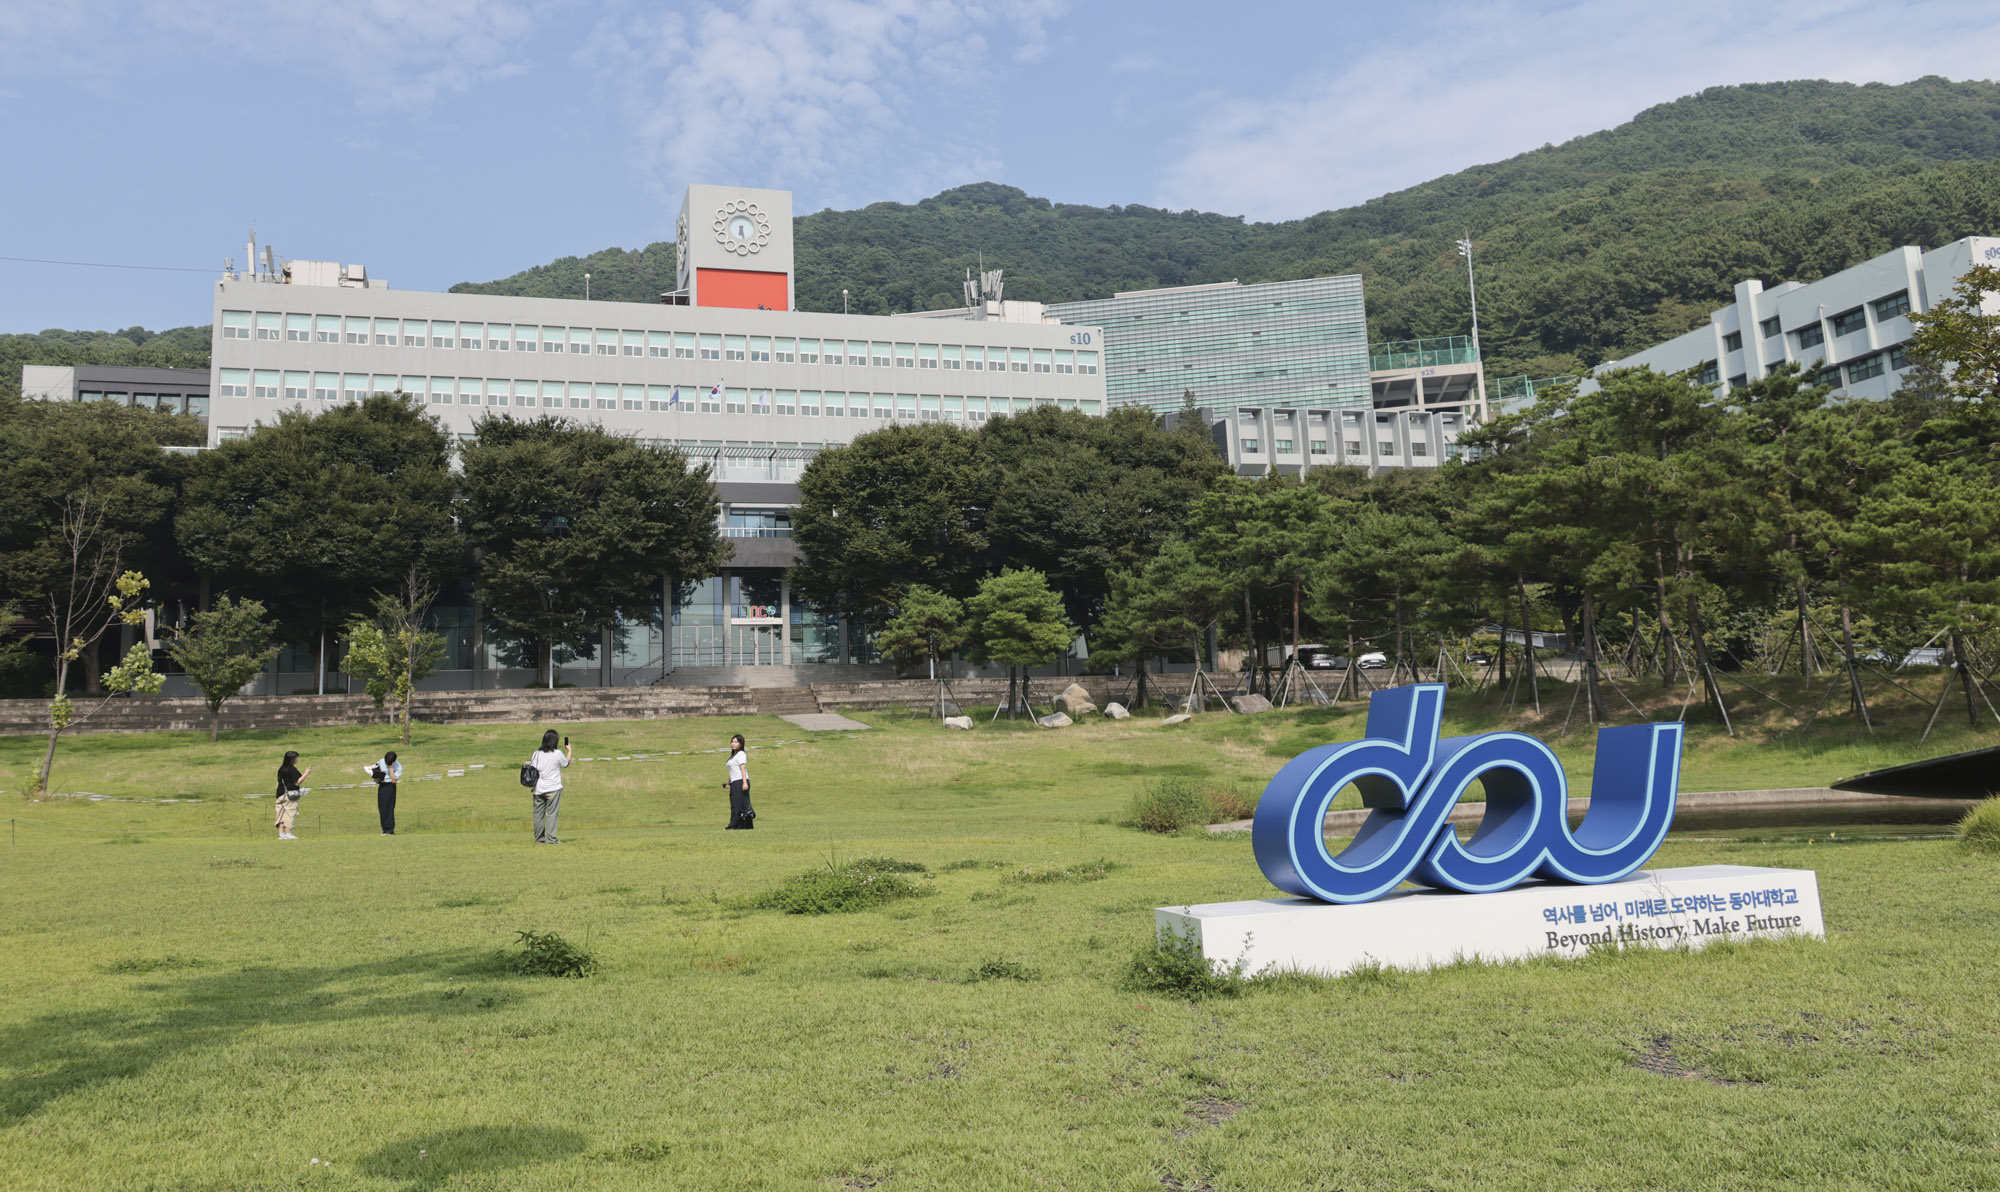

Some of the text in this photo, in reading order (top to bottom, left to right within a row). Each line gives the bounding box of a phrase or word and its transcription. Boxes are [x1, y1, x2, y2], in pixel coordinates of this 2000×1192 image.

[1070, 332, 1091, 345] s10
[1543, 888, 1799, 925] 역사를 넘어, 미래로 도약하는 동아대학교
[1545, 914, 1802, 952] Beyond History, Make Future
